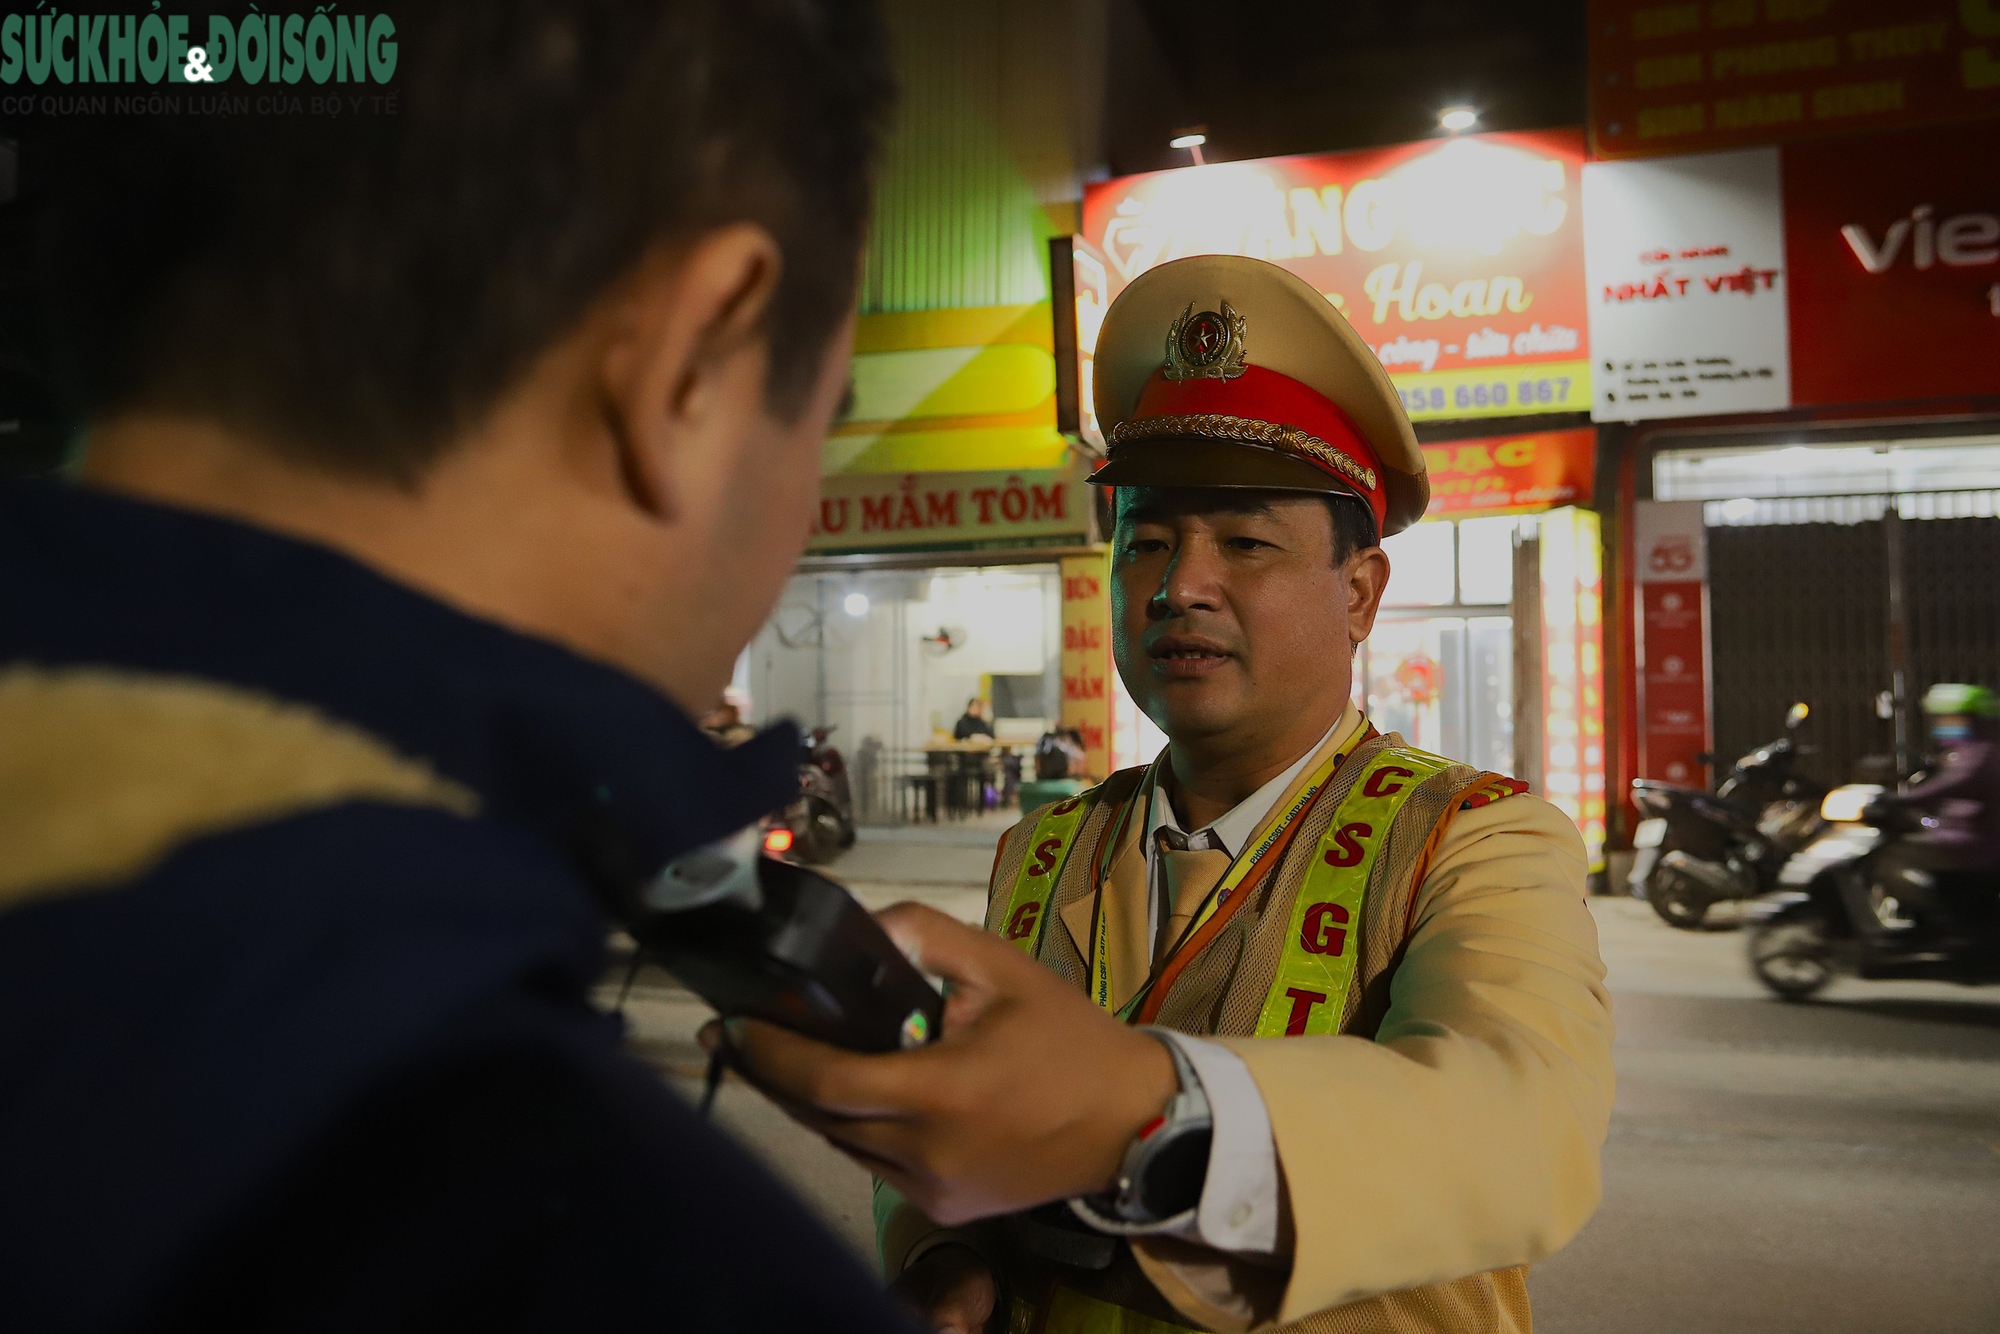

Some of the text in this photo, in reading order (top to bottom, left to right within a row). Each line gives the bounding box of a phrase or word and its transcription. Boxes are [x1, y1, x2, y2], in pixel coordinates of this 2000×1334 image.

[1363, 261, 1534, 324] Hoan
[1602, 264, 1779, 302] NHẤT VIỆT
[1455, 382, 1508, 409] 660
[860, 474, 959, 532] MẮM
[972, 476, 1070, 525] TÔM
[1250, 841, 1271, 864] PHÒNG
[1268, 824, 1285, 843] CSGT
[1285, 804, 1300, 821] CATP
